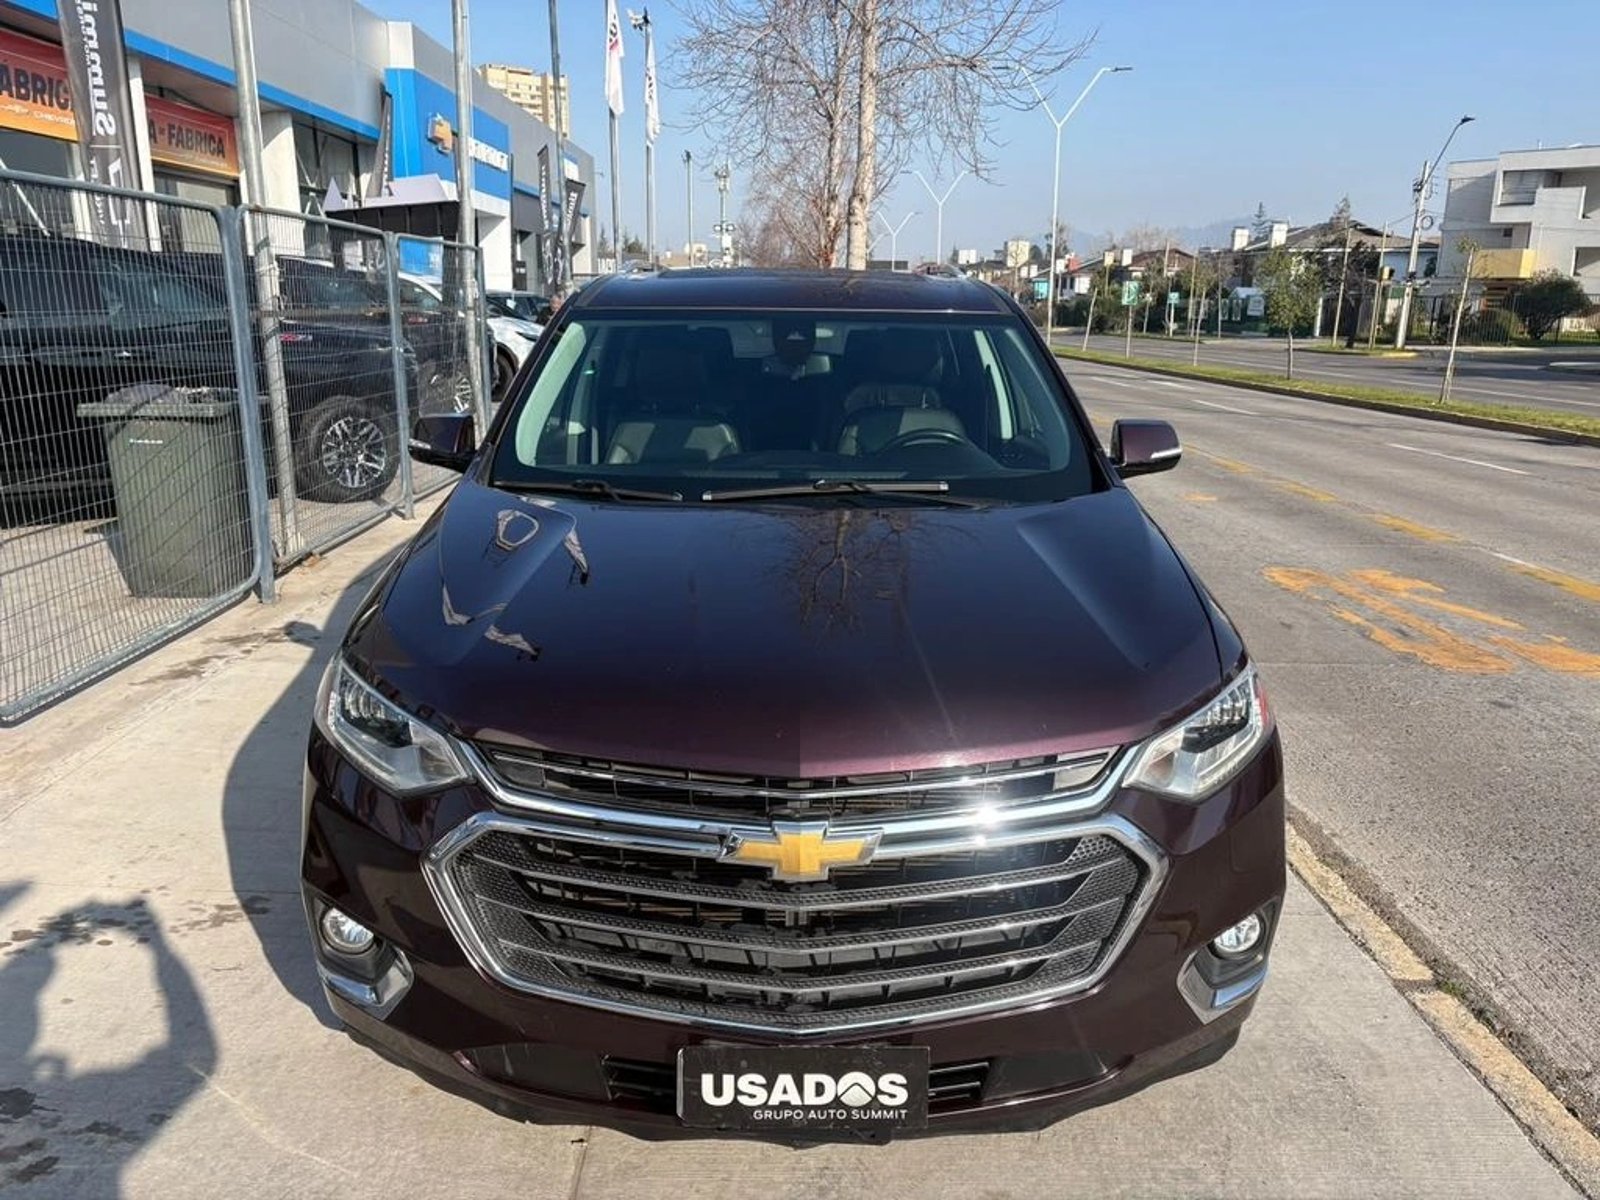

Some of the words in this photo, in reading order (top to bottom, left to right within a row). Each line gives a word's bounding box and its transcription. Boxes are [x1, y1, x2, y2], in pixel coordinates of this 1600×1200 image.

[701, 1071, 909, 1107] USADOS
[753, 1109, 804, 1121] GRUPO
[808, 1109, 848, 1120] AUTO
[851, 1109, 908, 1120] SUMMIT
